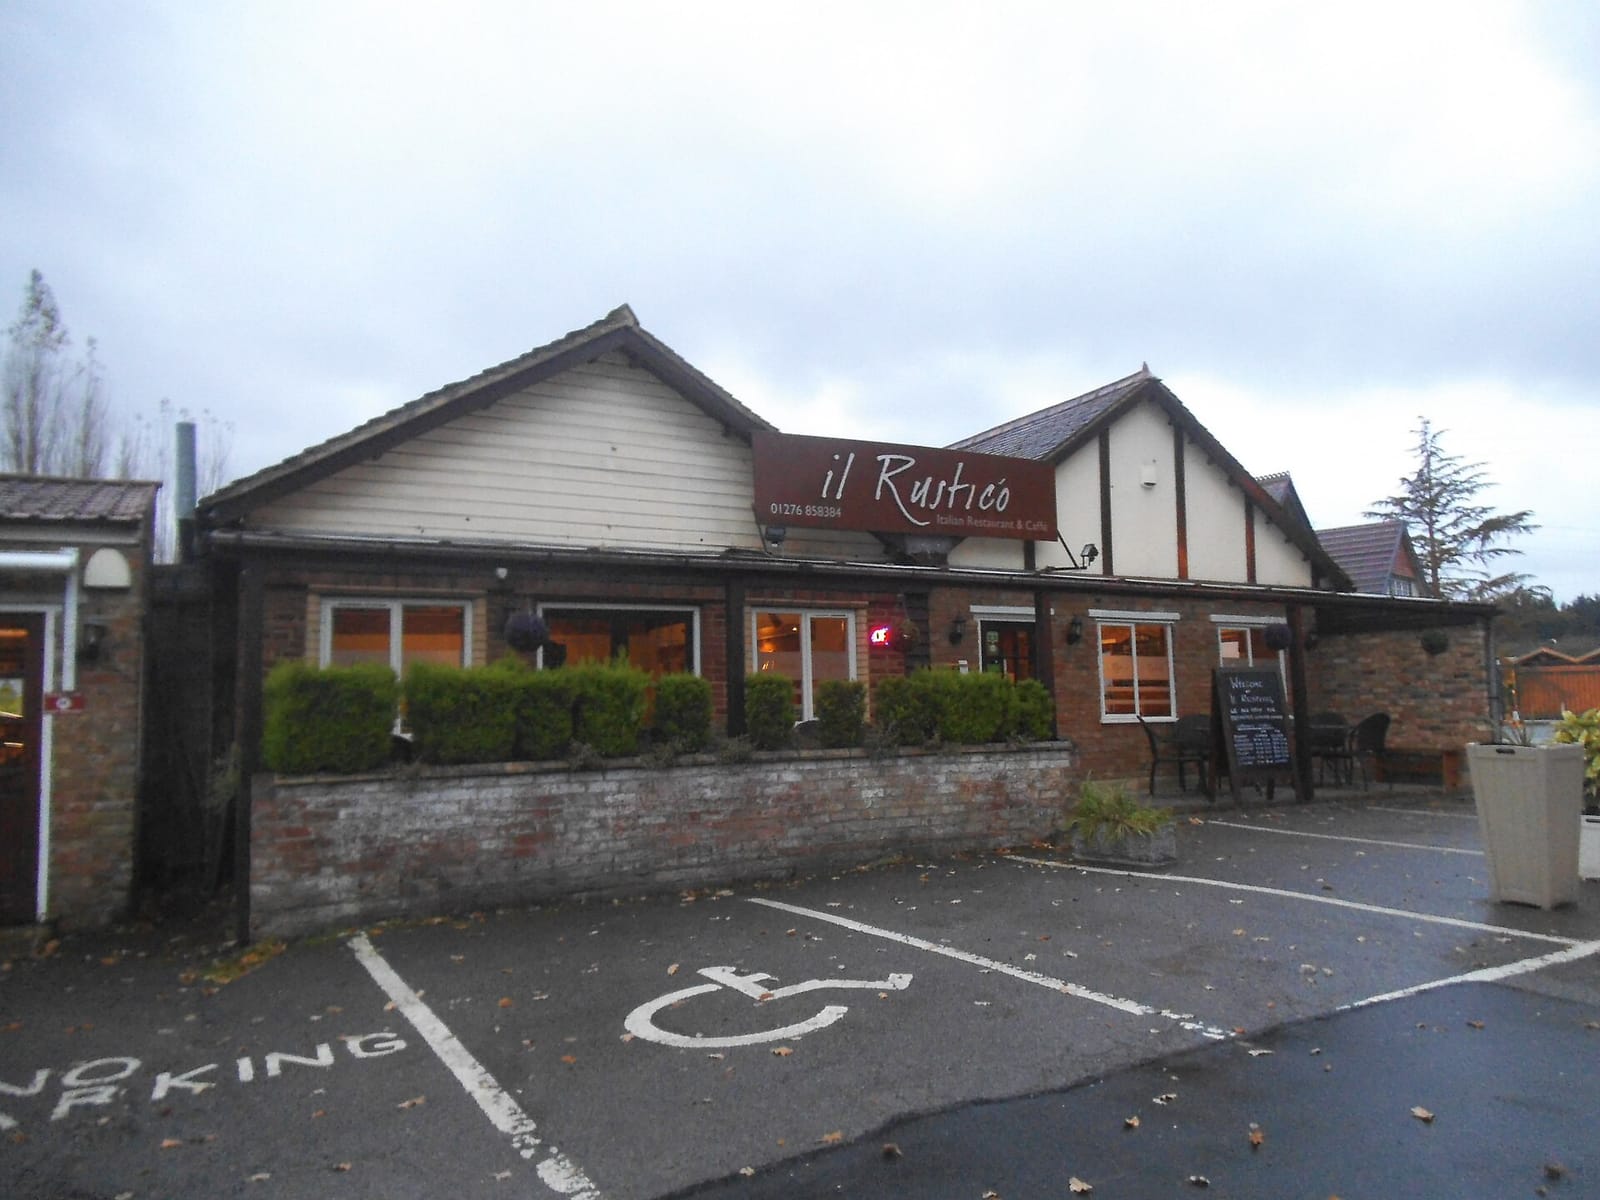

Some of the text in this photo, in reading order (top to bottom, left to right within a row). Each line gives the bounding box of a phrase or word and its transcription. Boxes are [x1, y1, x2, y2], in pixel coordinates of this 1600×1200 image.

[821, 452, 855, 500] il
[770, 502, 841, 518] 01276 858384
[936, 514, 964, 526] Italian
[967, 515, 1013, 529] Restaurant
[1016, 519, 1023, 530] &
